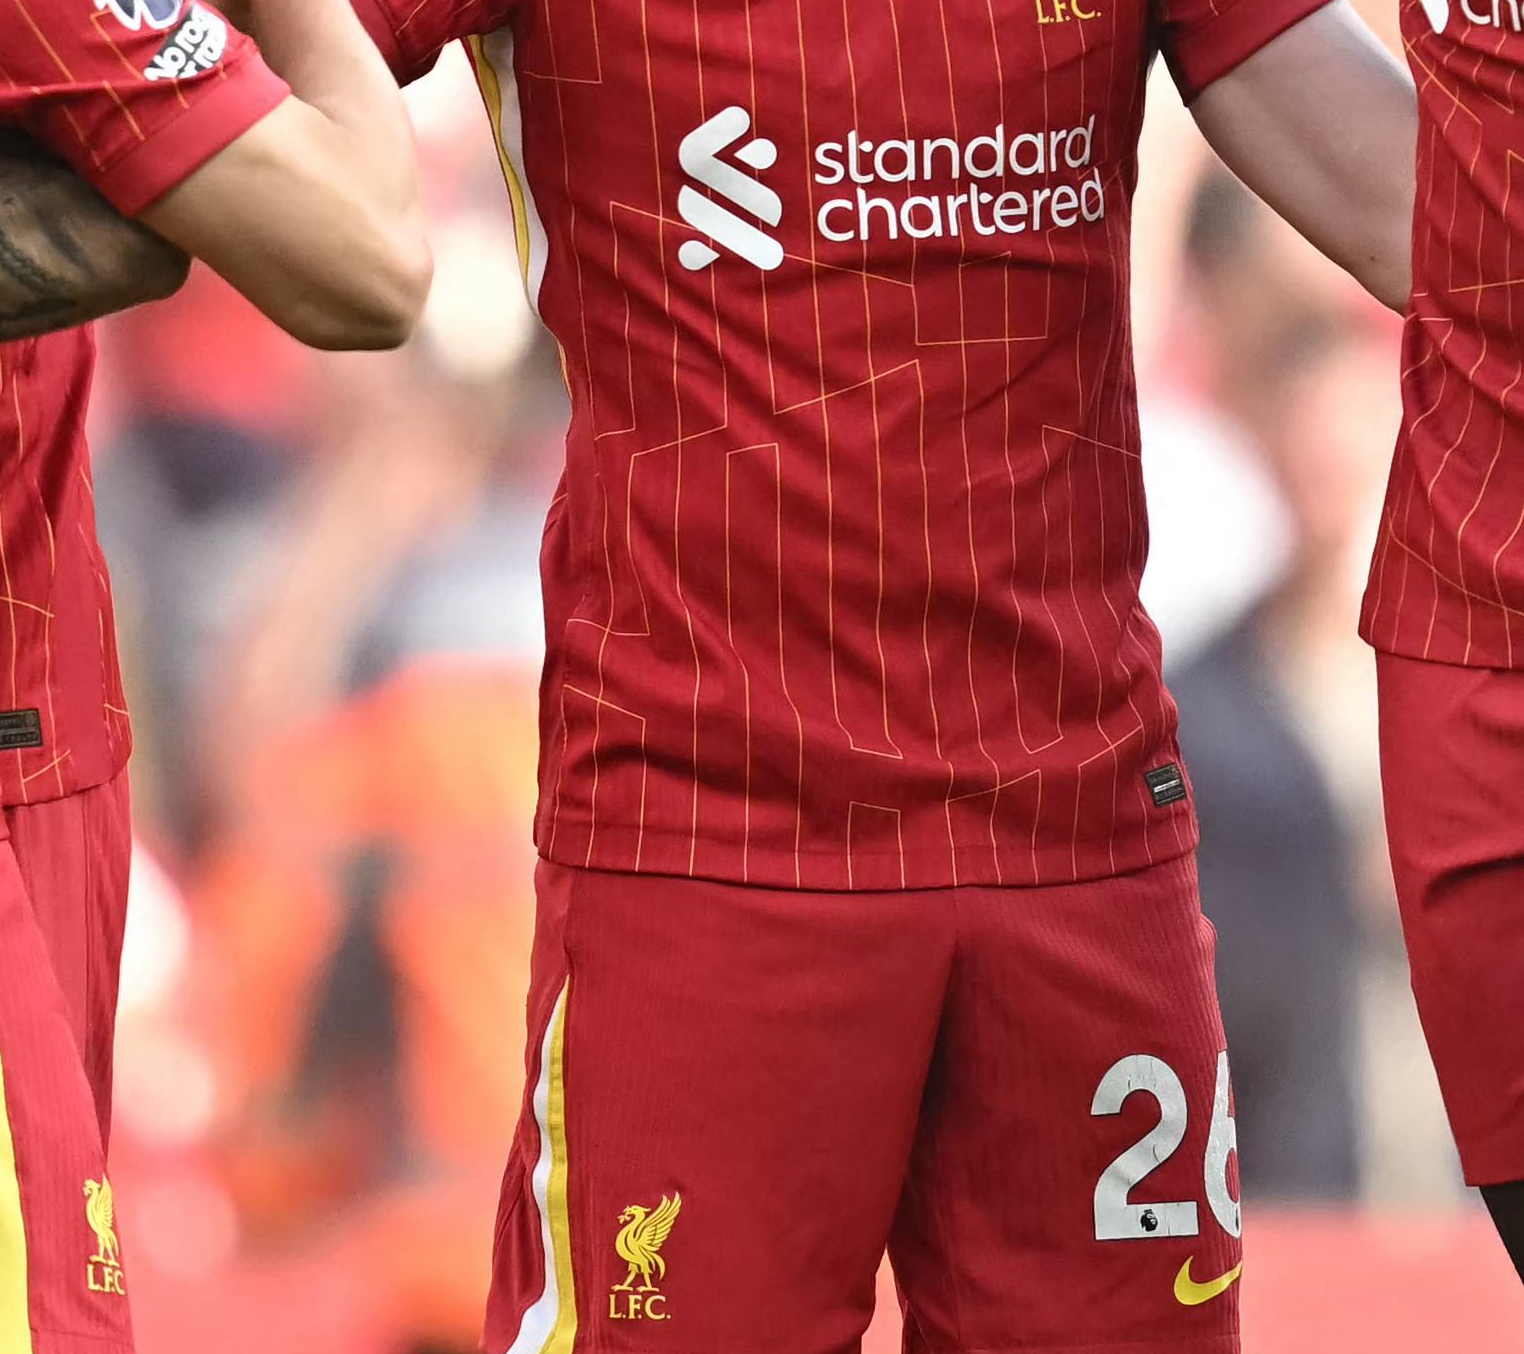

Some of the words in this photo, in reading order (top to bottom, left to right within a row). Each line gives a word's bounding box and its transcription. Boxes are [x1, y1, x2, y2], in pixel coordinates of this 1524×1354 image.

[814, 114, 1097, 183] standard
[815, 169, 1107, 244] chartered
[608, 1290, 672, 1321] L.F.C.
